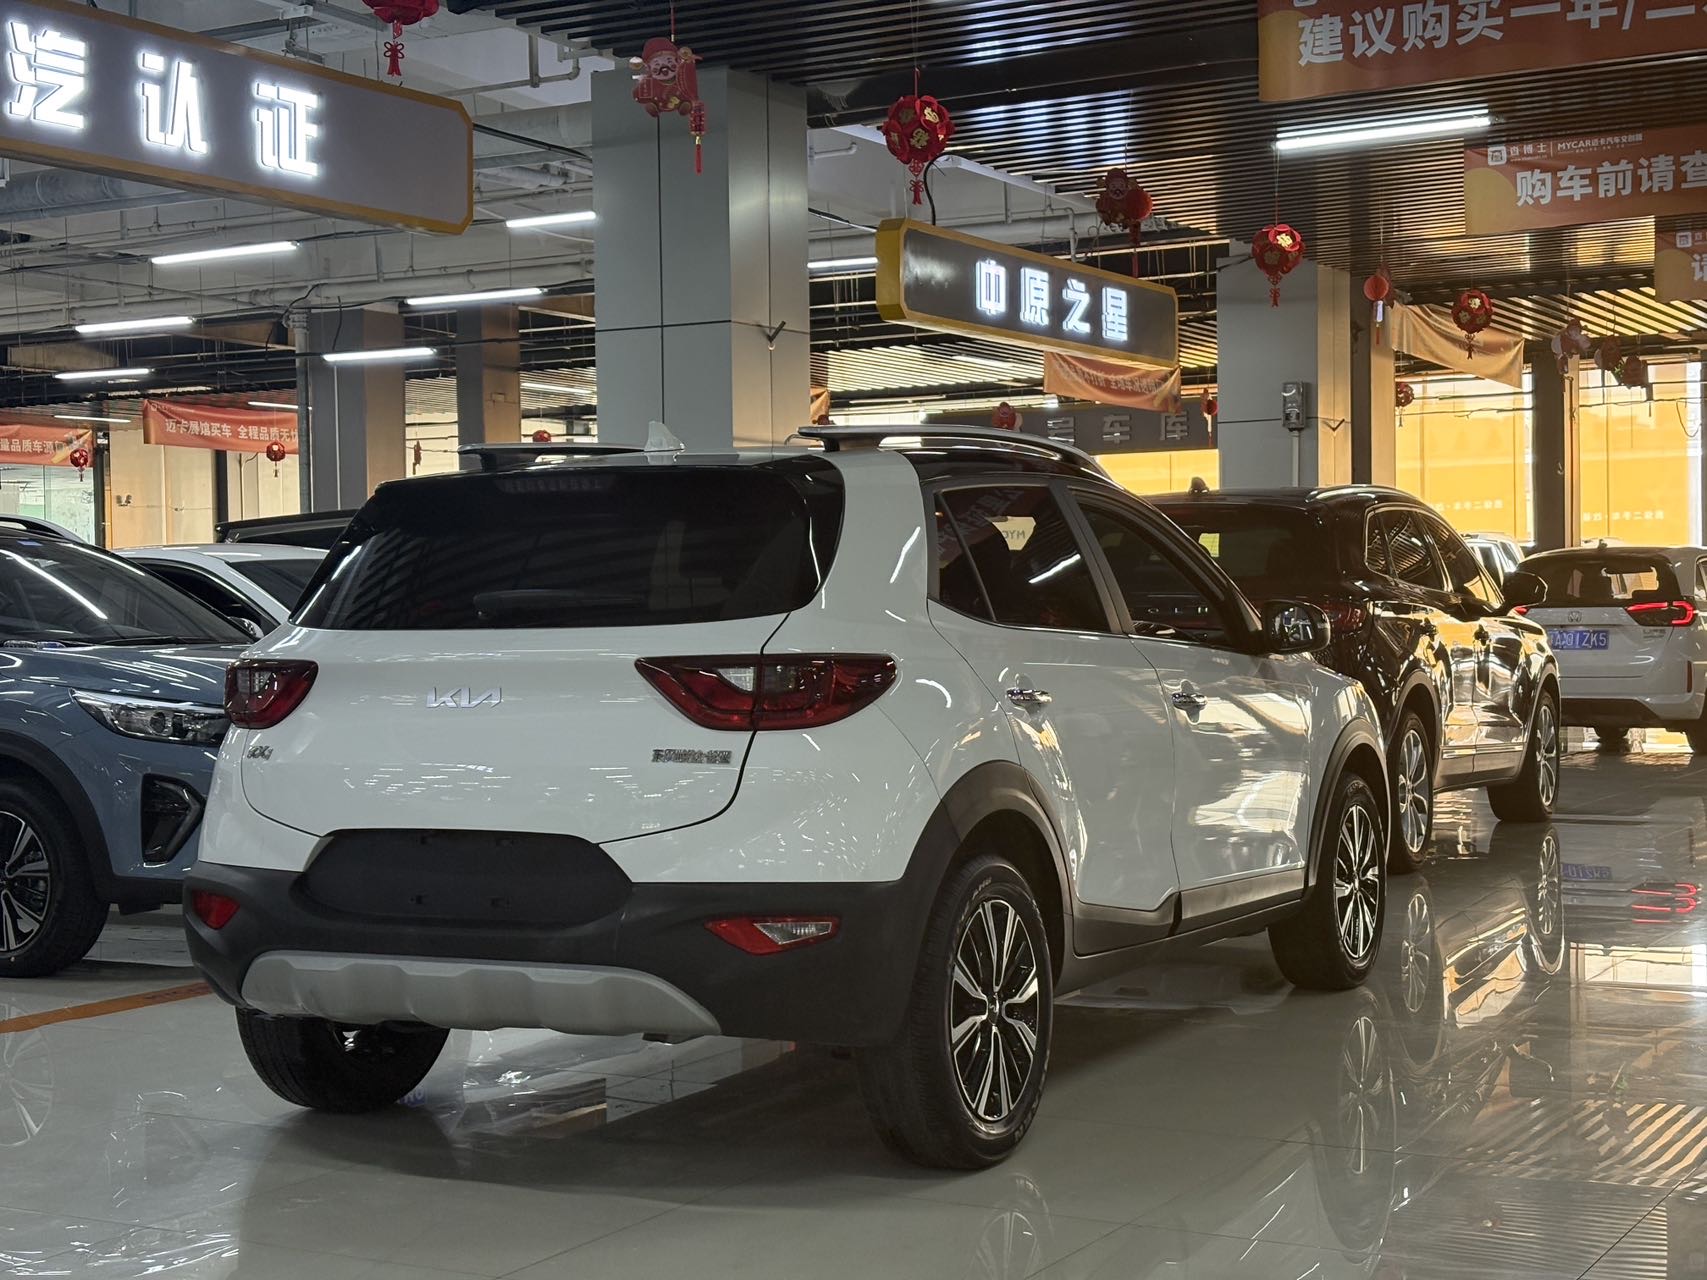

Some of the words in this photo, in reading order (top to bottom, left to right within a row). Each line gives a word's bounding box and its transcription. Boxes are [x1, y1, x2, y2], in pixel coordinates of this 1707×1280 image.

[975, 258, 1129, 342] 中原之星
[426, 686, 503, 709] KIA
